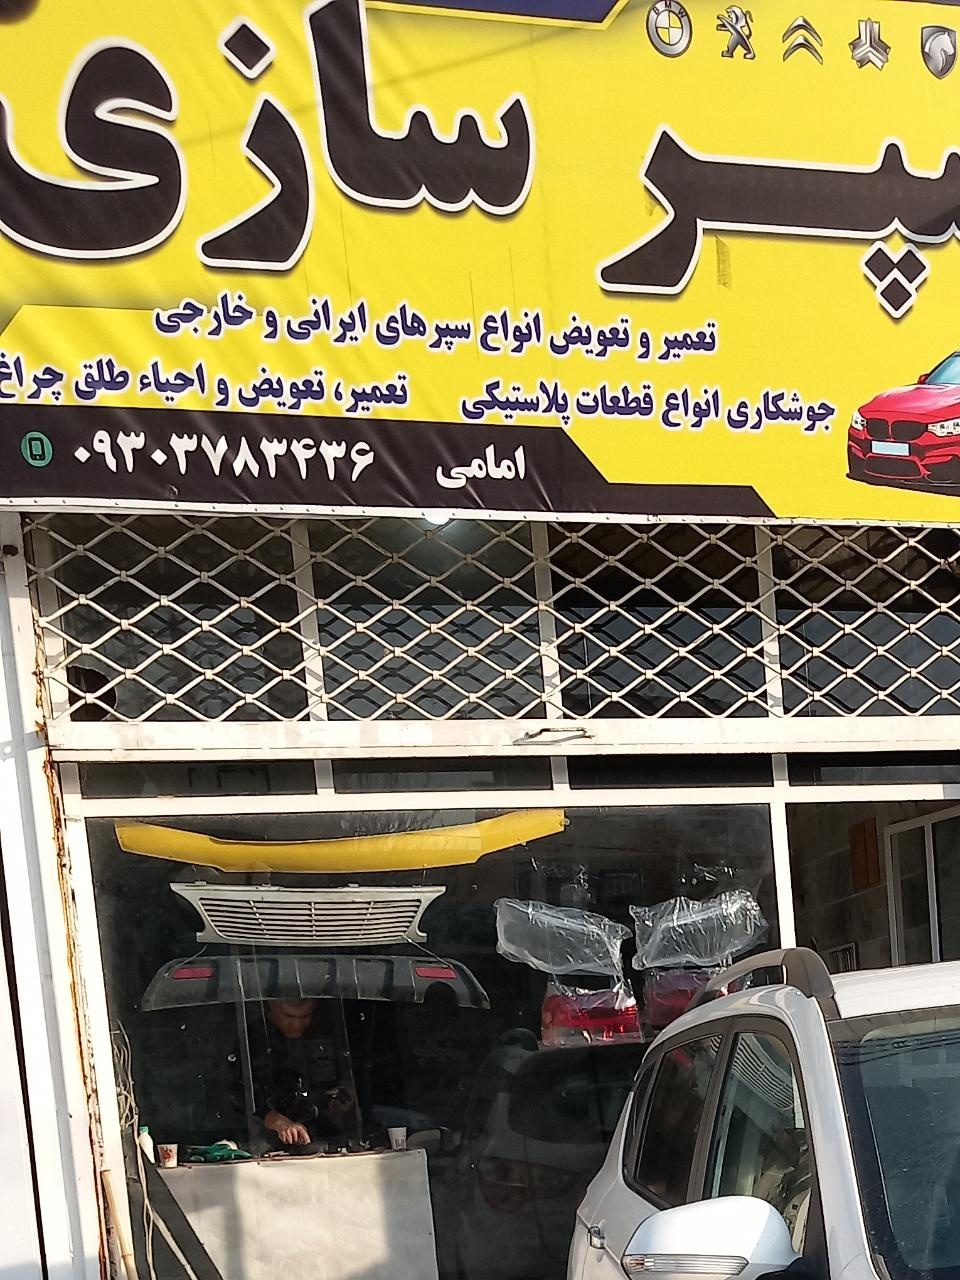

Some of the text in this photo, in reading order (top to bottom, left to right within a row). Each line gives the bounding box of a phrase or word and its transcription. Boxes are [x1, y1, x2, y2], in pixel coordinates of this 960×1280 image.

[652, 0, 687, 18] BMW
[0, 0, 533, 267] سازی
[155, 293, 254, 337] خارجی
[264, 310, 278, 340] و
[286, 299, 367, 344] ایرانی
[480, 311, 541, 354] انواع
[549, 315, 631, 358] تعویض
[637, 331, 650, 360] و
[658, 321, 717, 362] تعمیر
[74, 357, 130, 401] طلق
[139, 361, 206, 402] احیاء
[216, 377, 230, 408] و
[238, 367, 325, 411] تعویض
[461, 380, 836, 433] جوشکاری انواع قطعات پلاستیکی
[74, 430, 526, 489] امامی ۰۹۳۰۳۷۸۳۴۳۶
